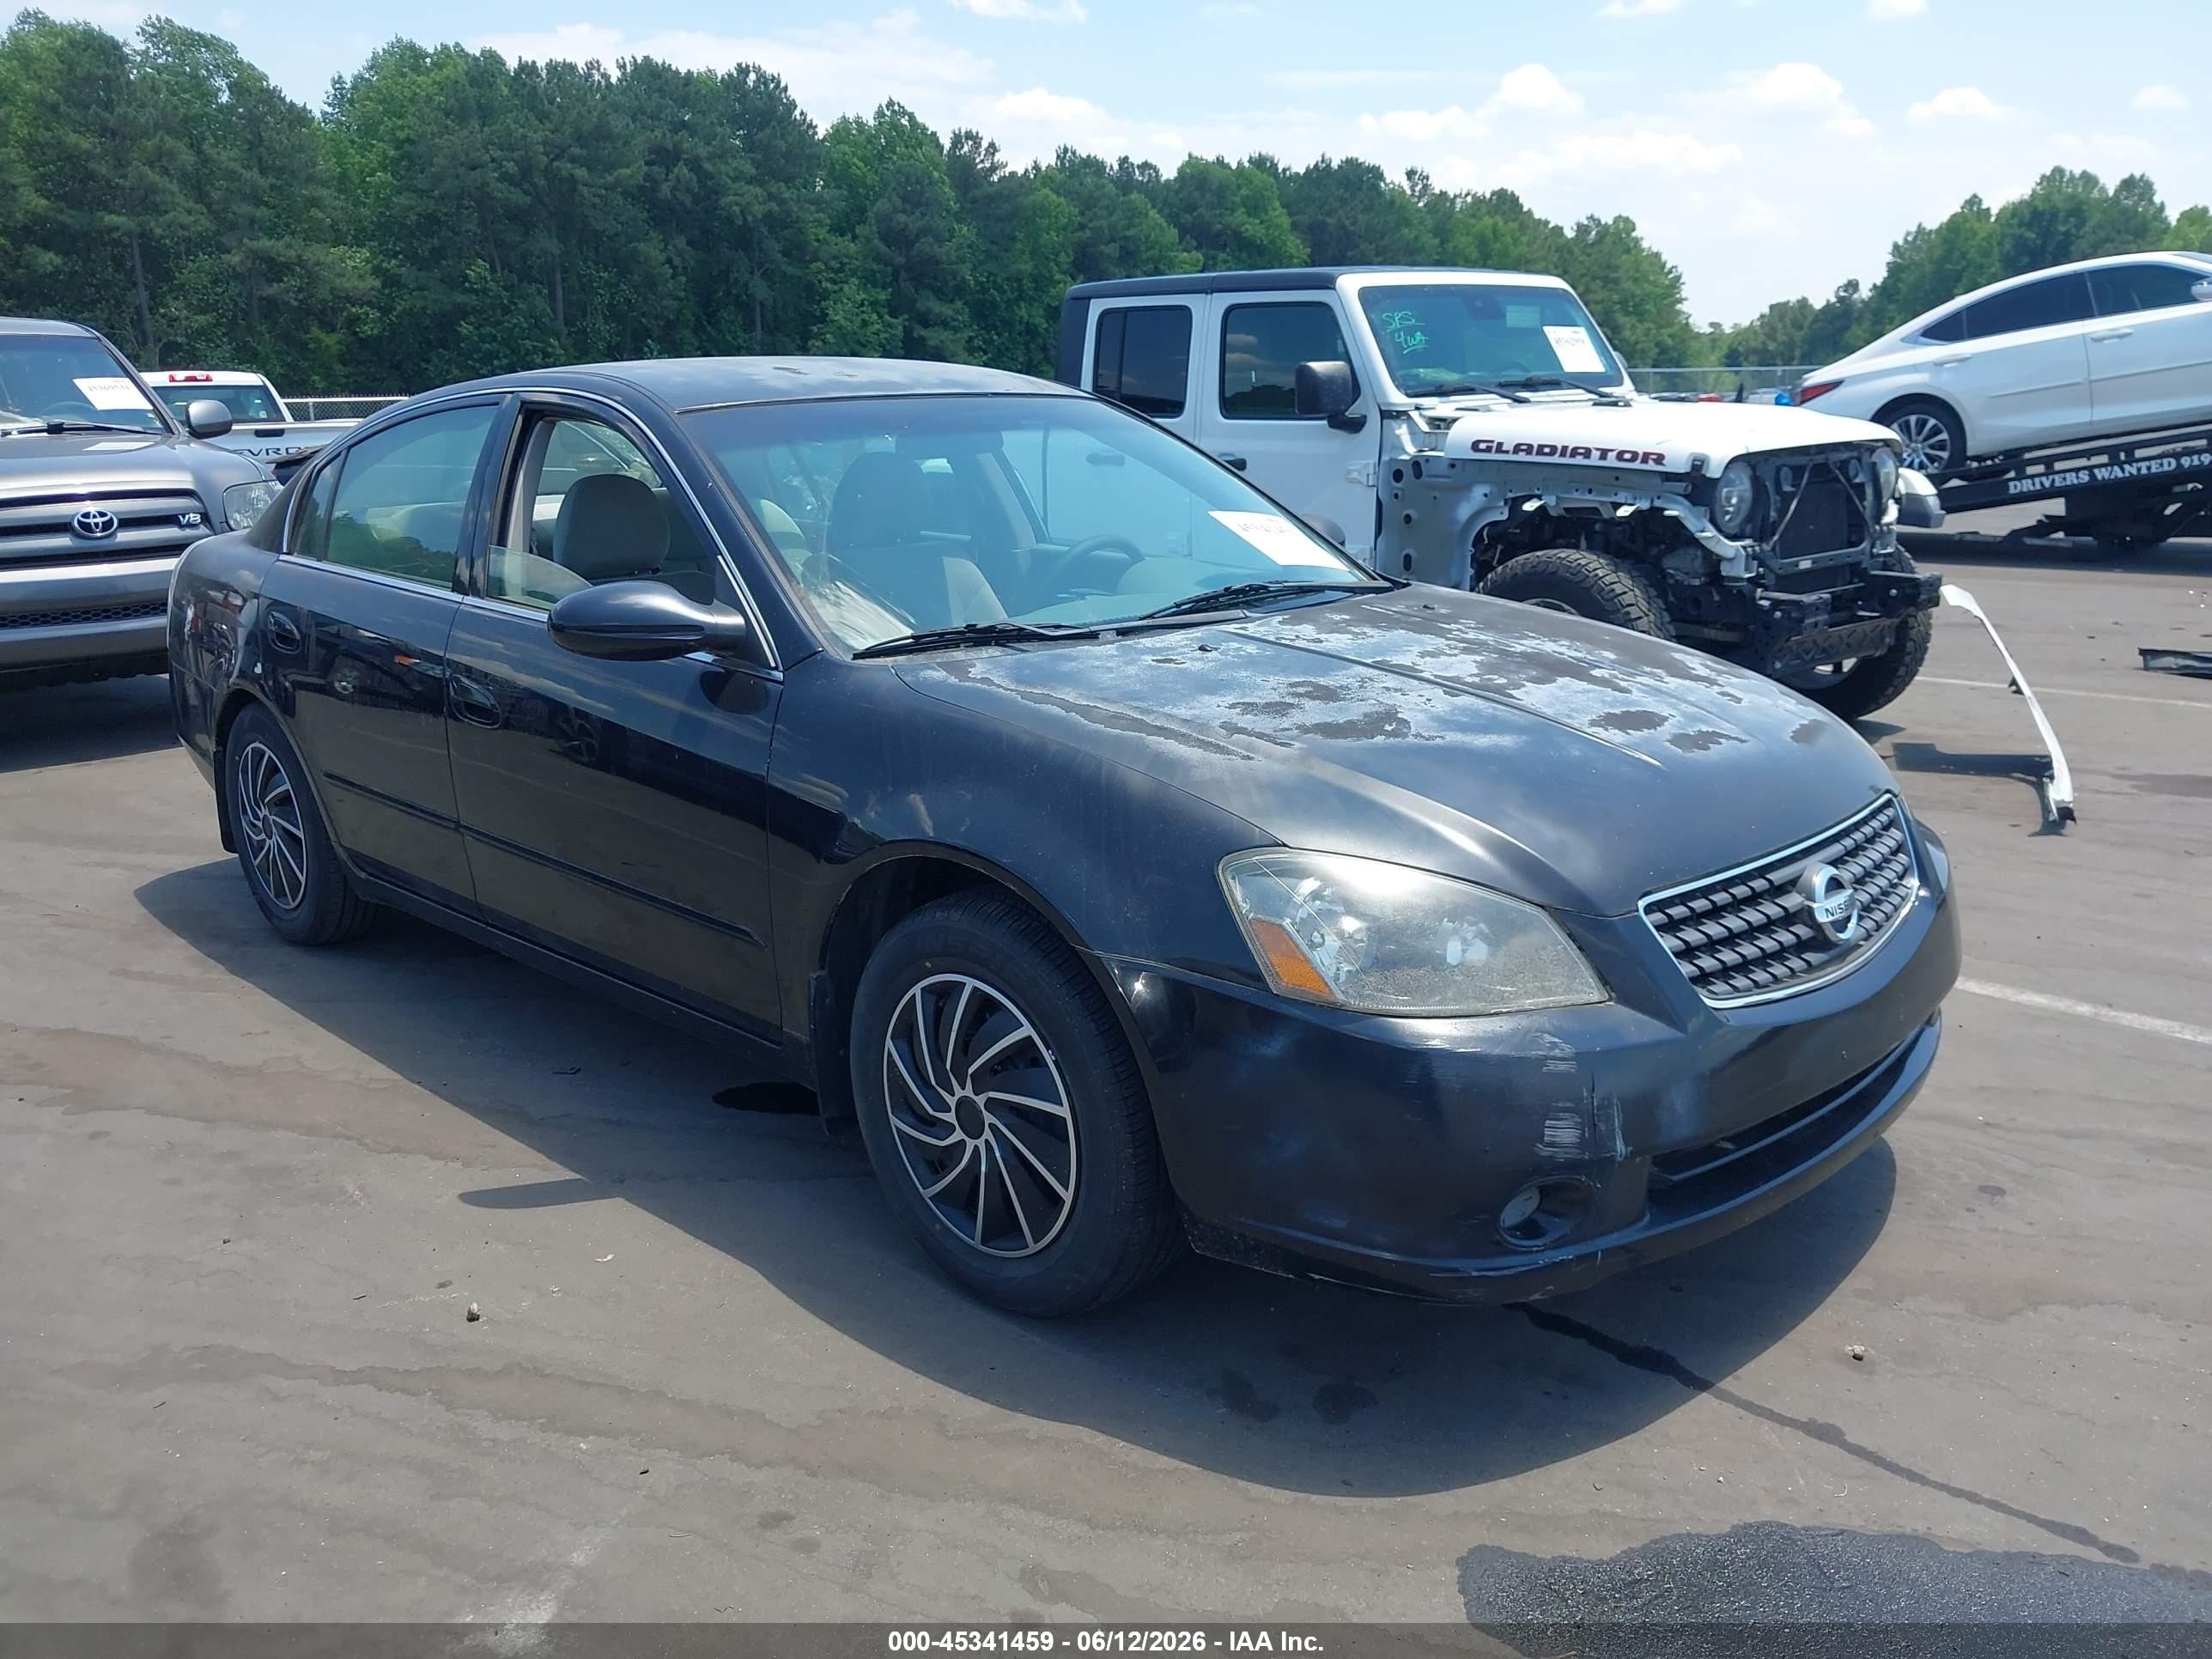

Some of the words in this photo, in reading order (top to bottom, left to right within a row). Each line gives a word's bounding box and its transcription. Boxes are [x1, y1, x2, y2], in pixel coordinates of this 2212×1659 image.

[1471, 439, 1667, 466] GLADIATOR
[2008, 470, 2089, 495] DRIVERS
[2093, 457, 2177, 481] WANTED
[178, 513, 201, 525] V8
